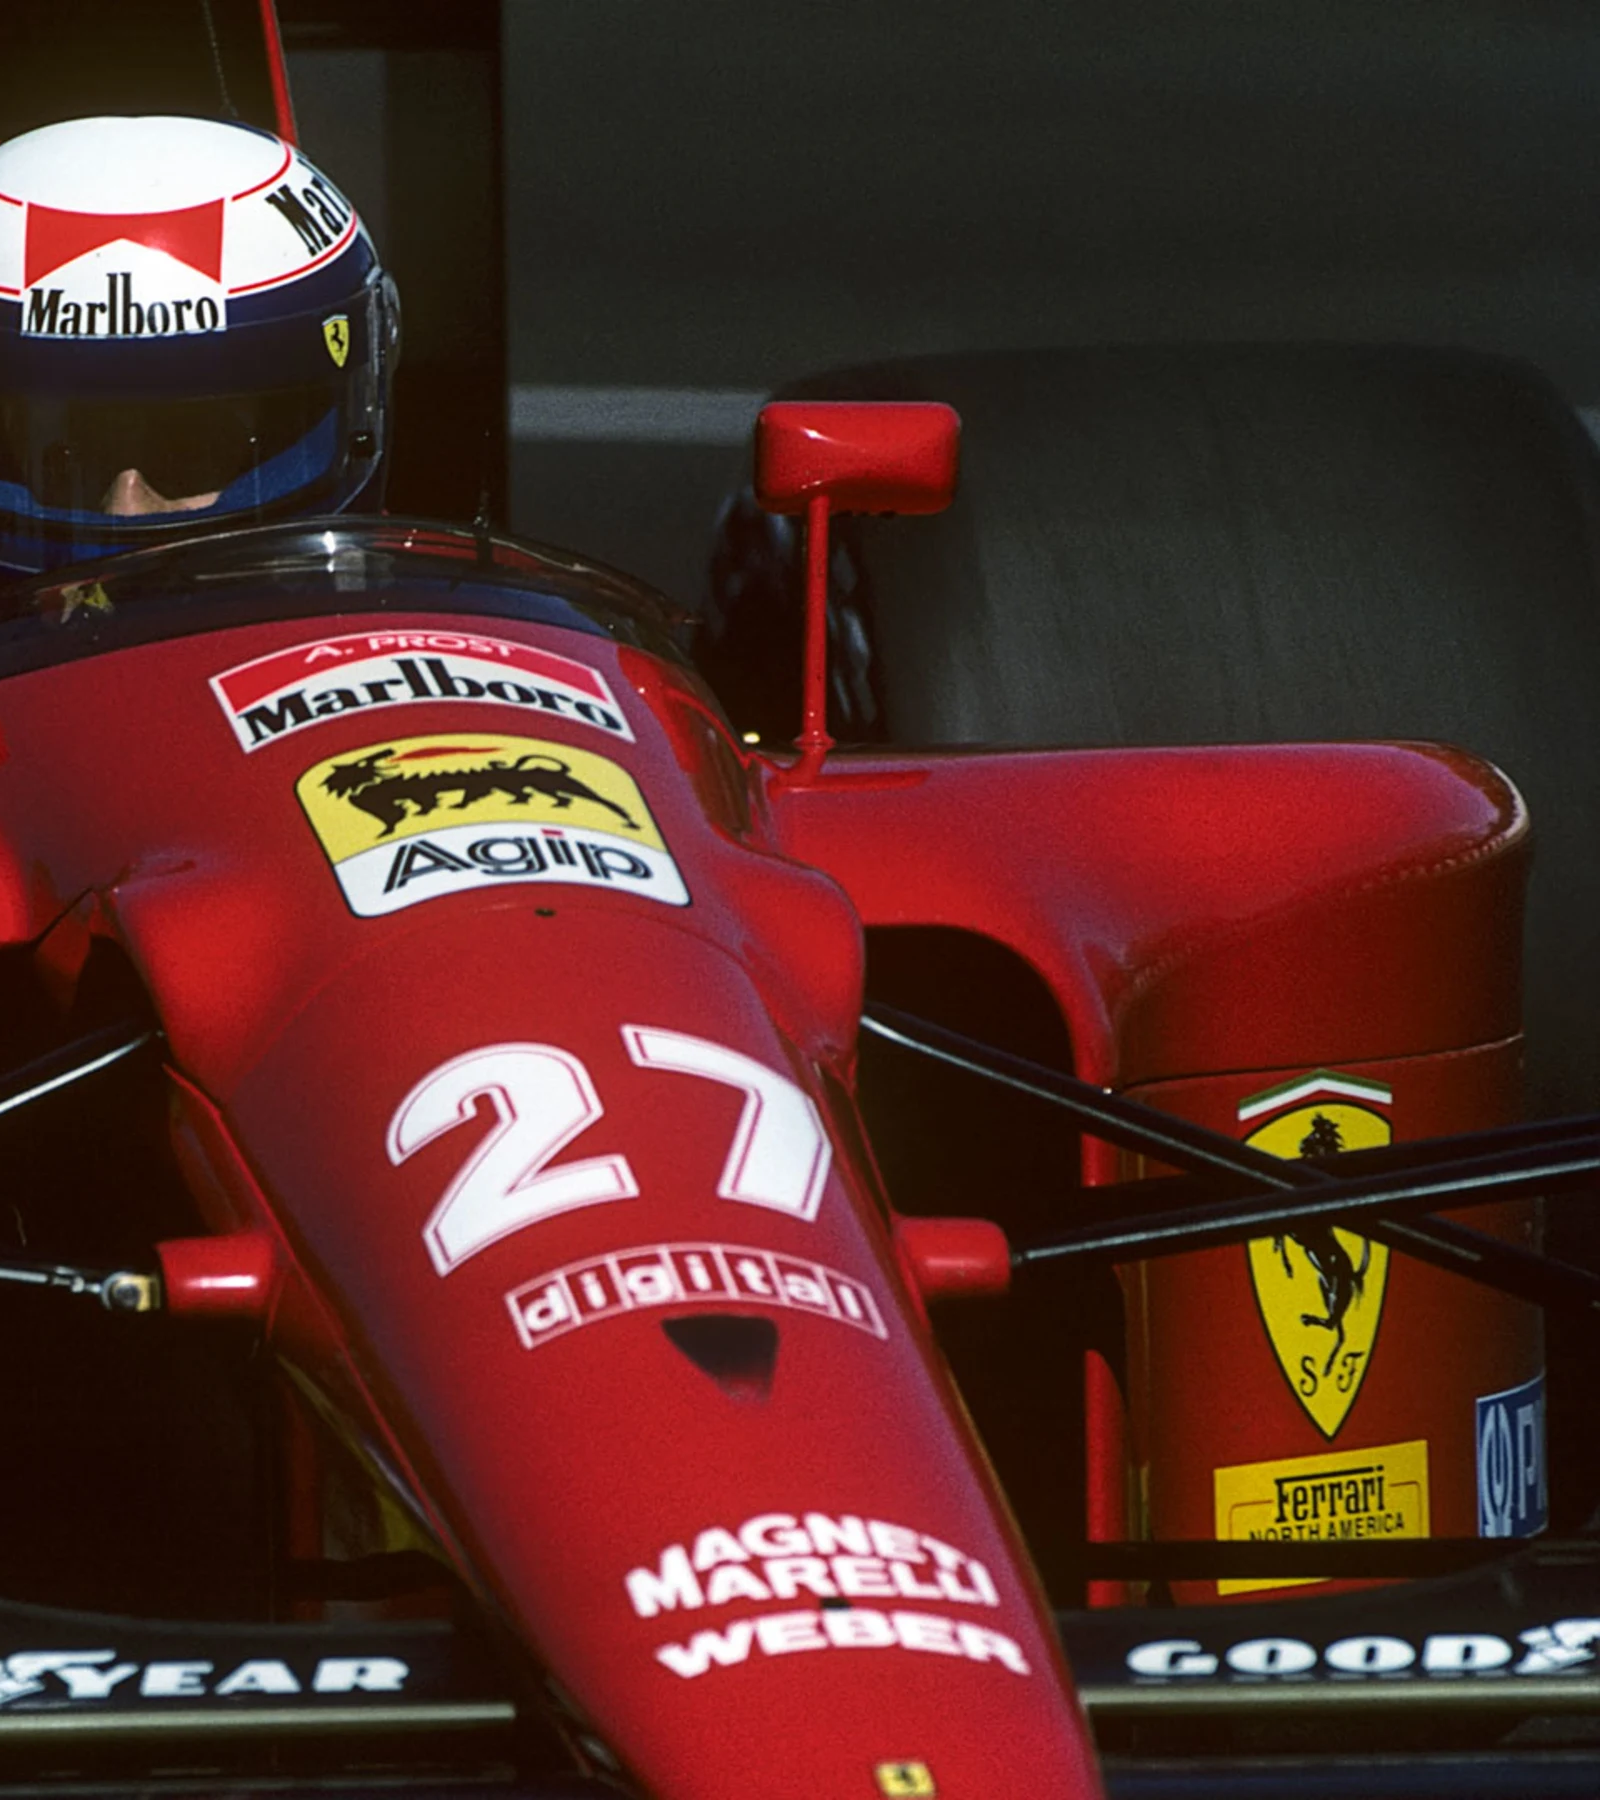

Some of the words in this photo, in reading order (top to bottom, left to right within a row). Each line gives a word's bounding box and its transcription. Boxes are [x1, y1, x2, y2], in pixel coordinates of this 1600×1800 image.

[28, 272, 219, 336] Marlboro
[304, 645, 354, 664] A.
[368, 635, 515, 657] PROST
[238, 657, 623, 745] Marlboro
[382, 828, 653, 895] Agip
[385, 1023, 834, 1278] 27
[519, 1254, 868, 1334] digital
[1299, 1354, 1318, 1397] S
[1274, 1465, 1385, 1523] Ferrari
[1328, 1511, 1405, 1541] AMERICA
[625, 1512, 999, 1610] MAGNETI
[654, 1608, 1032, 1679] WEBER
